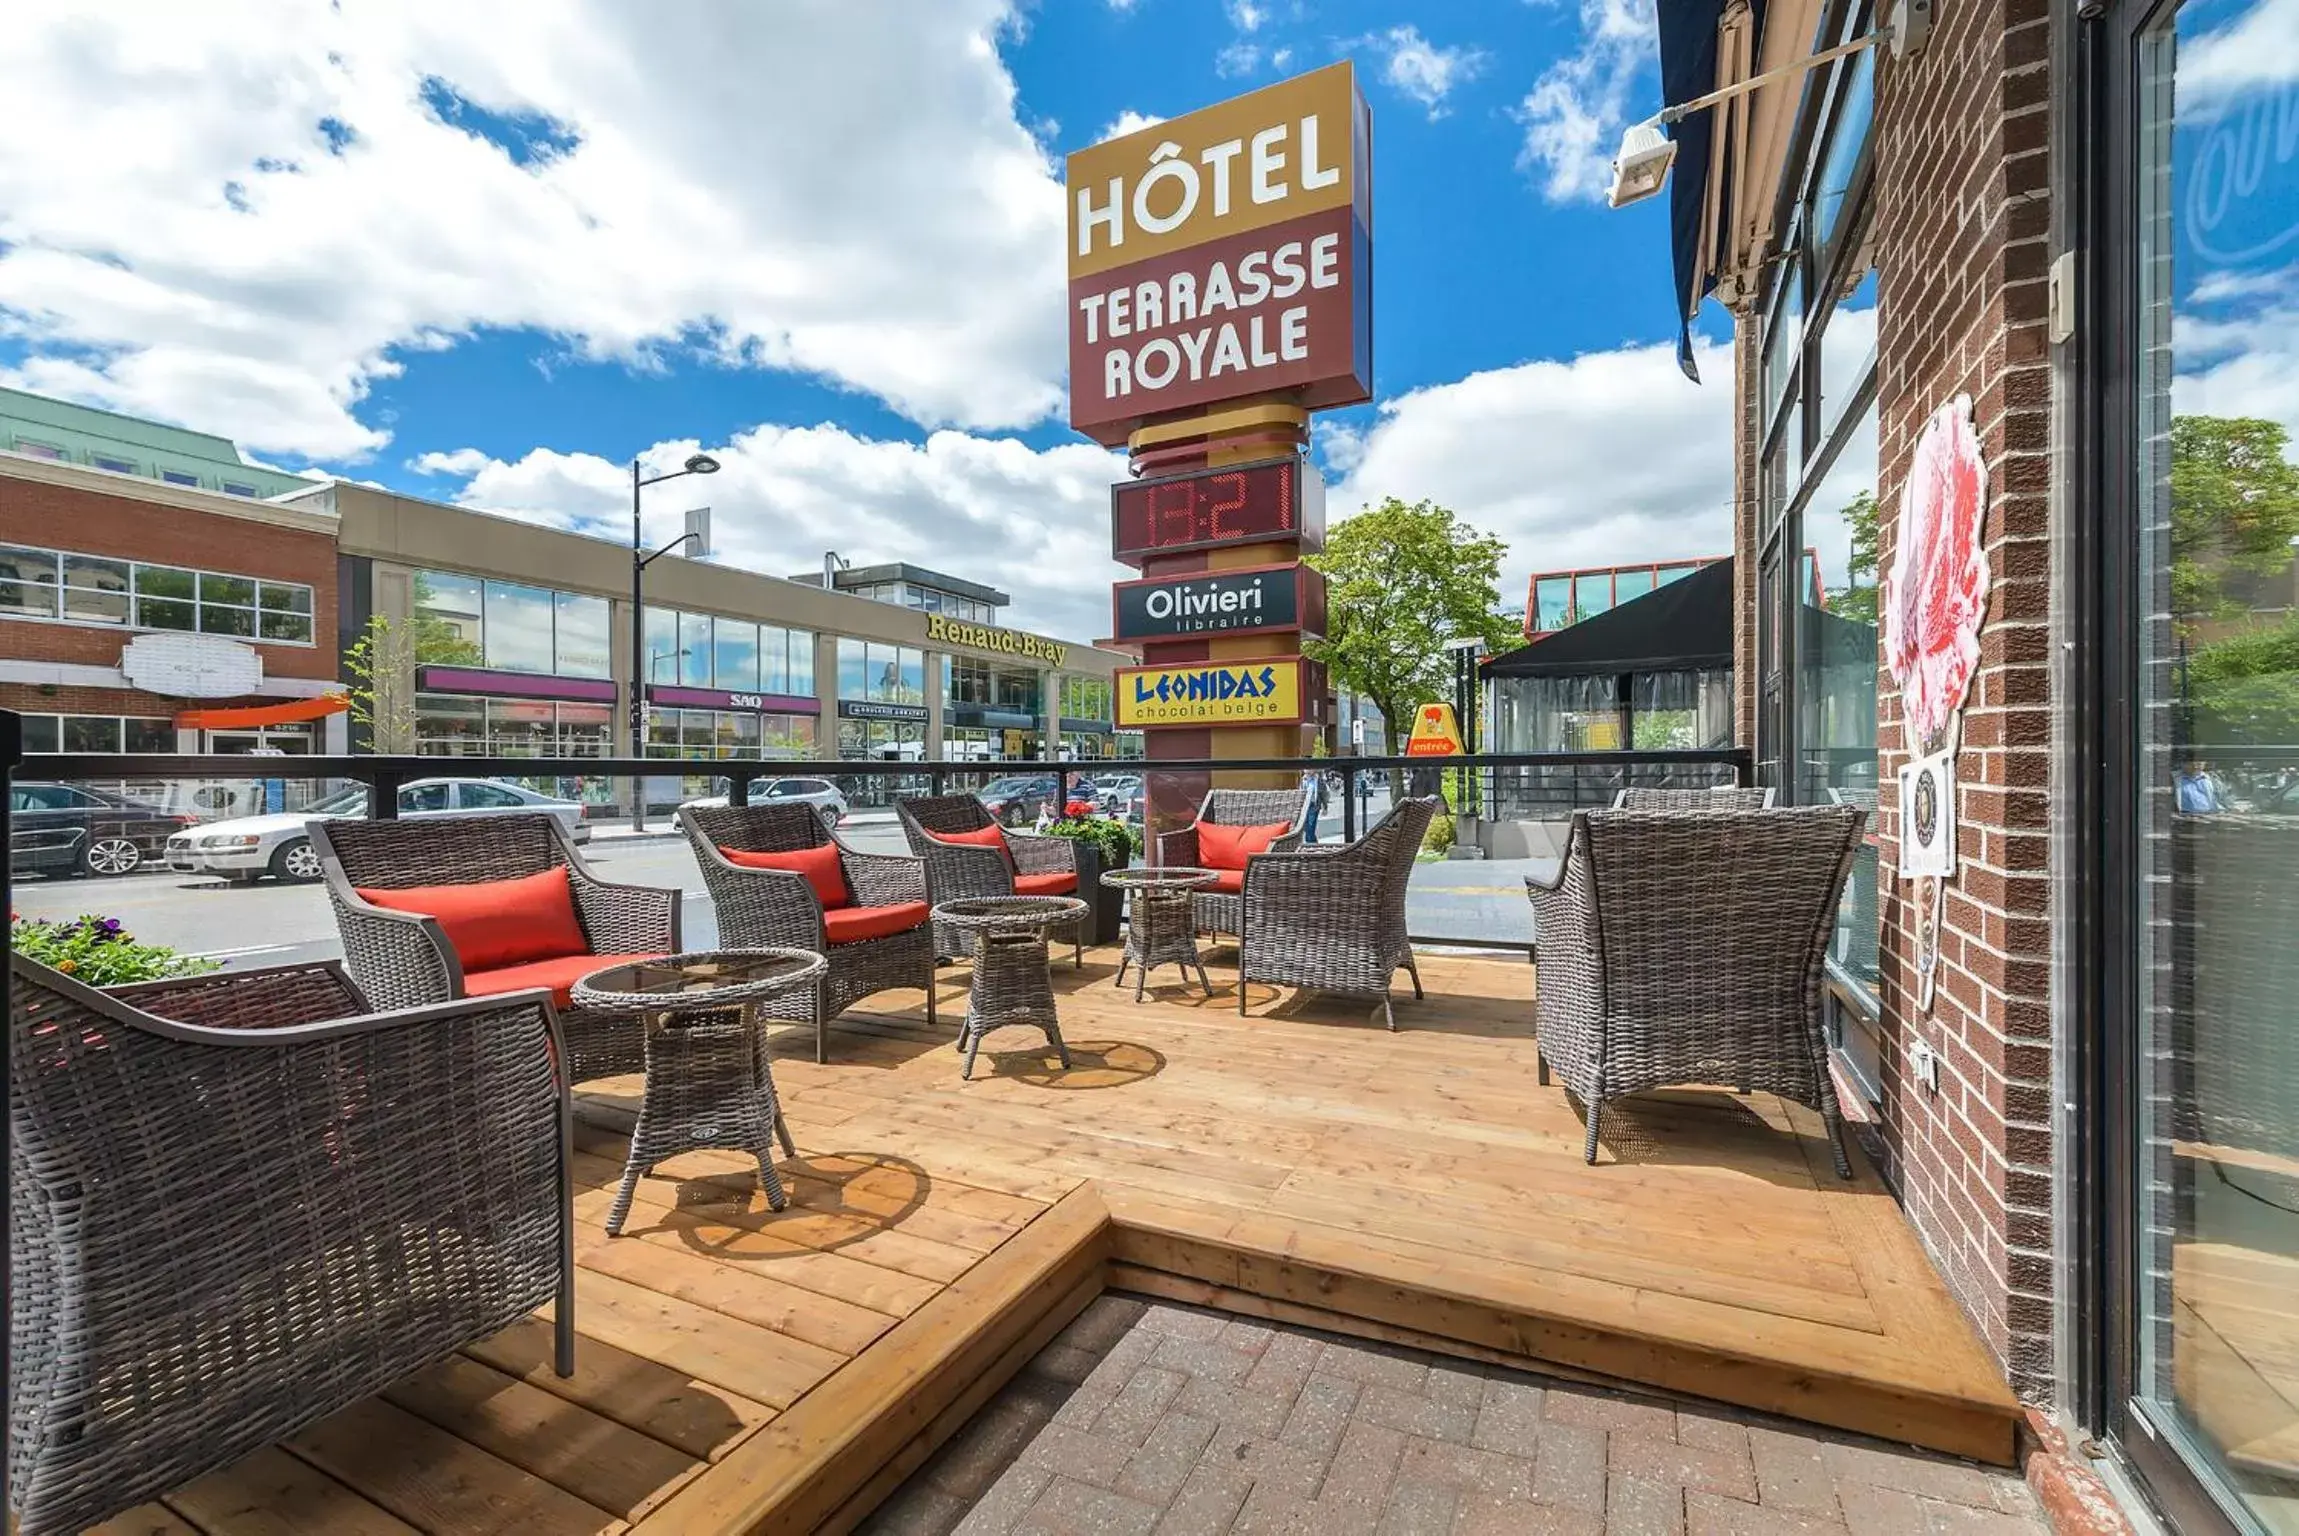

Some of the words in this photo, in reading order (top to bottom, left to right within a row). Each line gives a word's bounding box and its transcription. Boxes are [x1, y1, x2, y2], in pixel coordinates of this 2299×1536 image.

[1077, 115, 1339, 256] HÔTEL
[1080, 232, 1339, 344] TERRASSE
[1105, 306, 1308, 398] ROYALE
[1146, 578, 1262, 619] Olivieri
[927, 612, 1067, 667] Renaud-Bray
[1176, 616, 1262, 632] libraire
[1135, 666, 1276, 703] LEONIDAS
[1136, 704, 1215, 718] chocolat
[1223, 702, 1278, 716] belge
